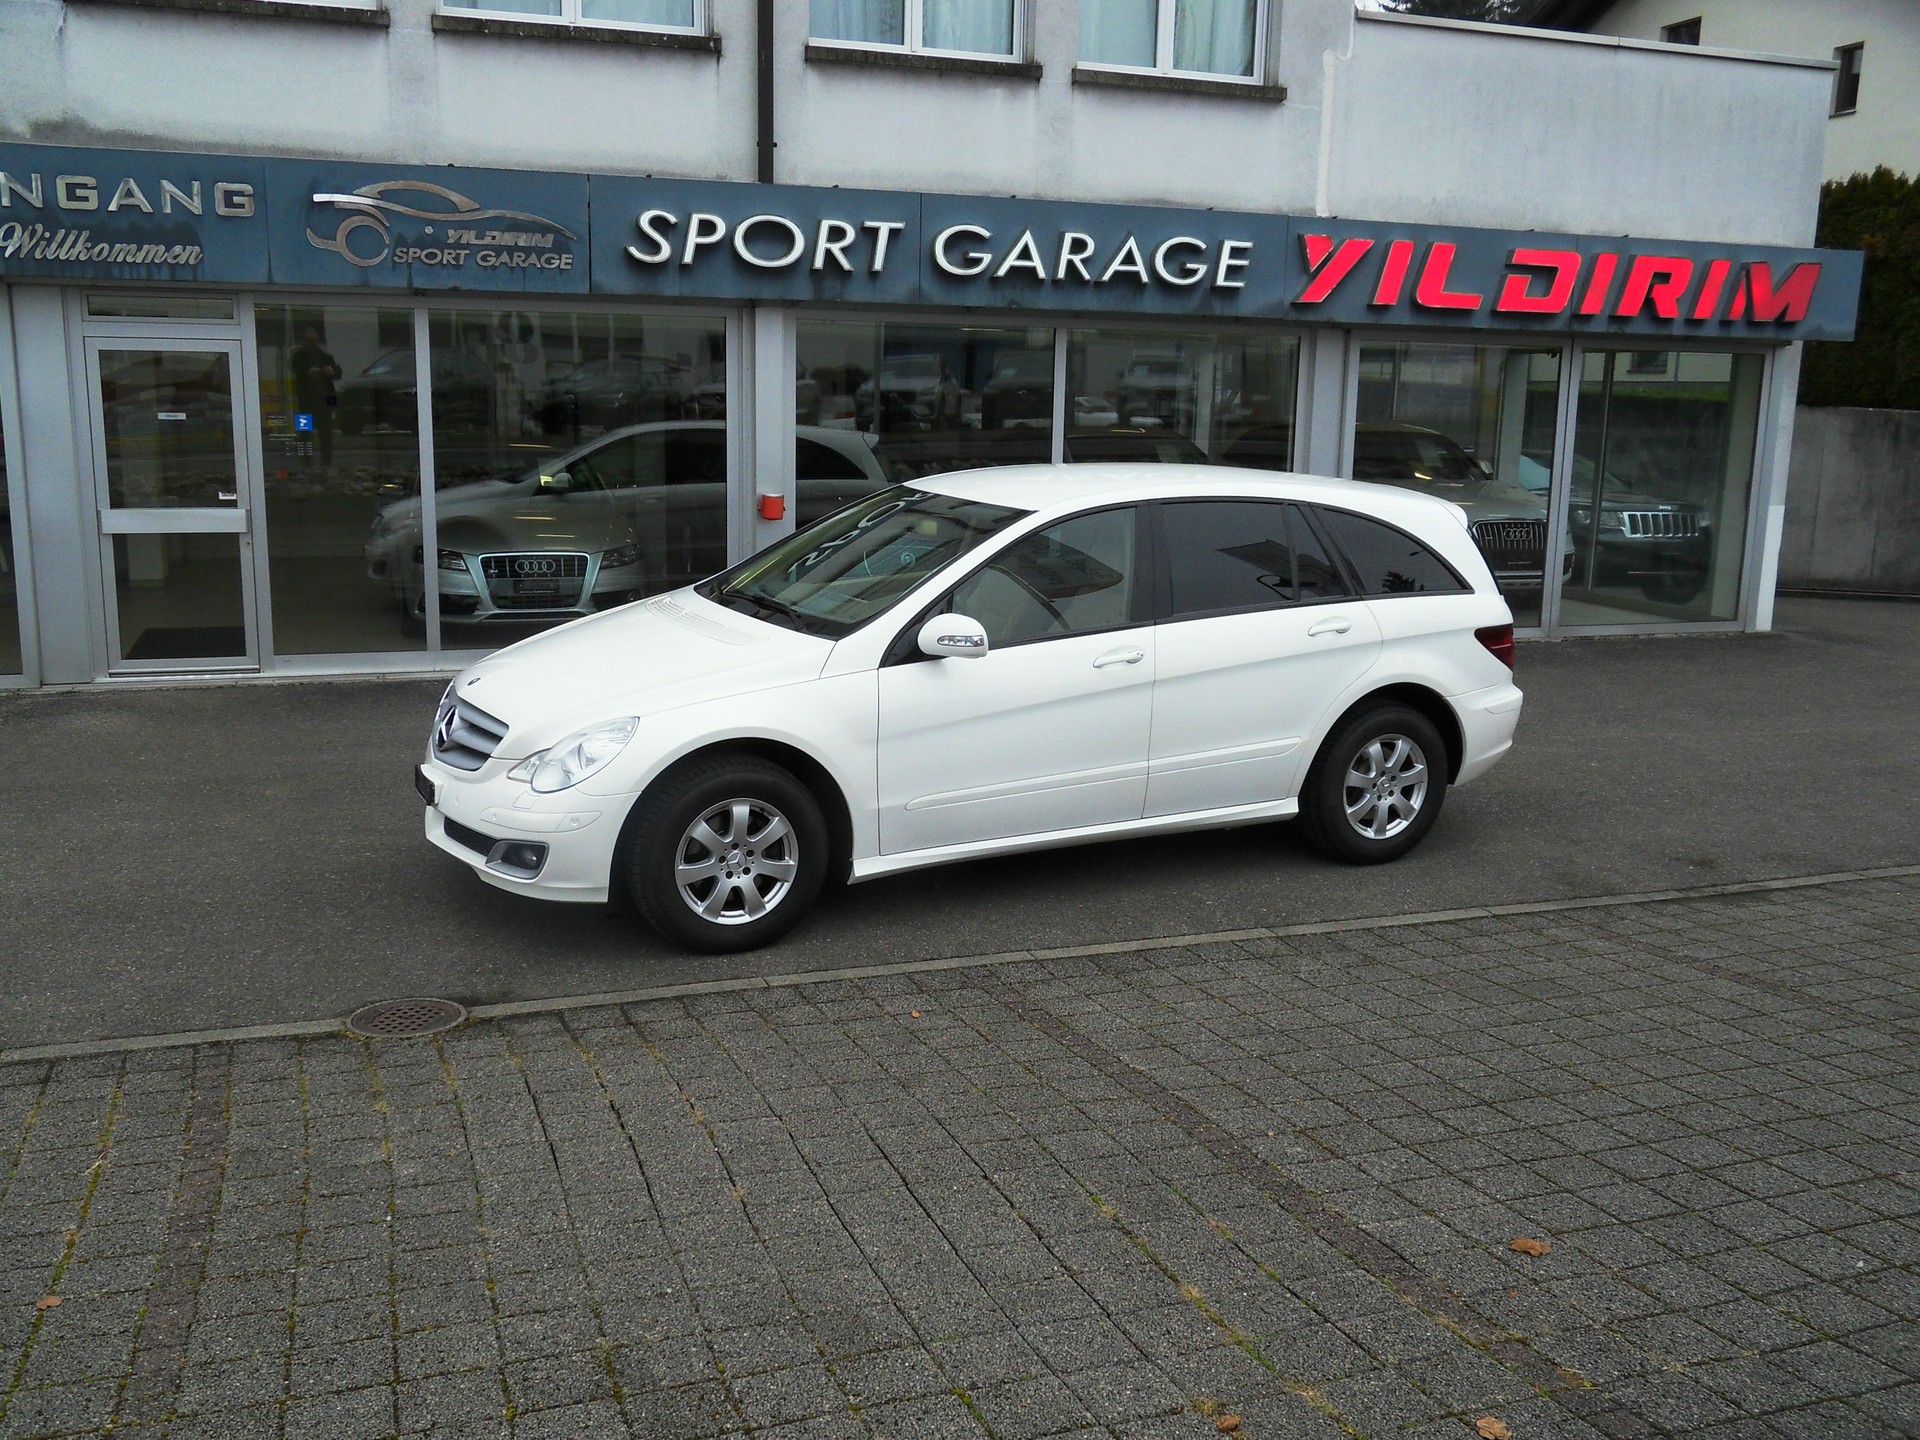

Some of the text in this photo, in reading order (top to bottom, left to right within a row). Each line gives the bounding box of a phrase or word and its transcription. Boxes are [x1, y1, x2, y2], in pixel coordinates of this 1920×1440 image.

[0, 171, 256, 218] NGANG
[0, 221, 204, 266] Willkommen
[393, 247, 574, 270] SPORT GARAGE
[446, 228, 555, 248] YILDIRIM
[625, 209, 1823, 322] SPORT GARAGE YILDIRIM
